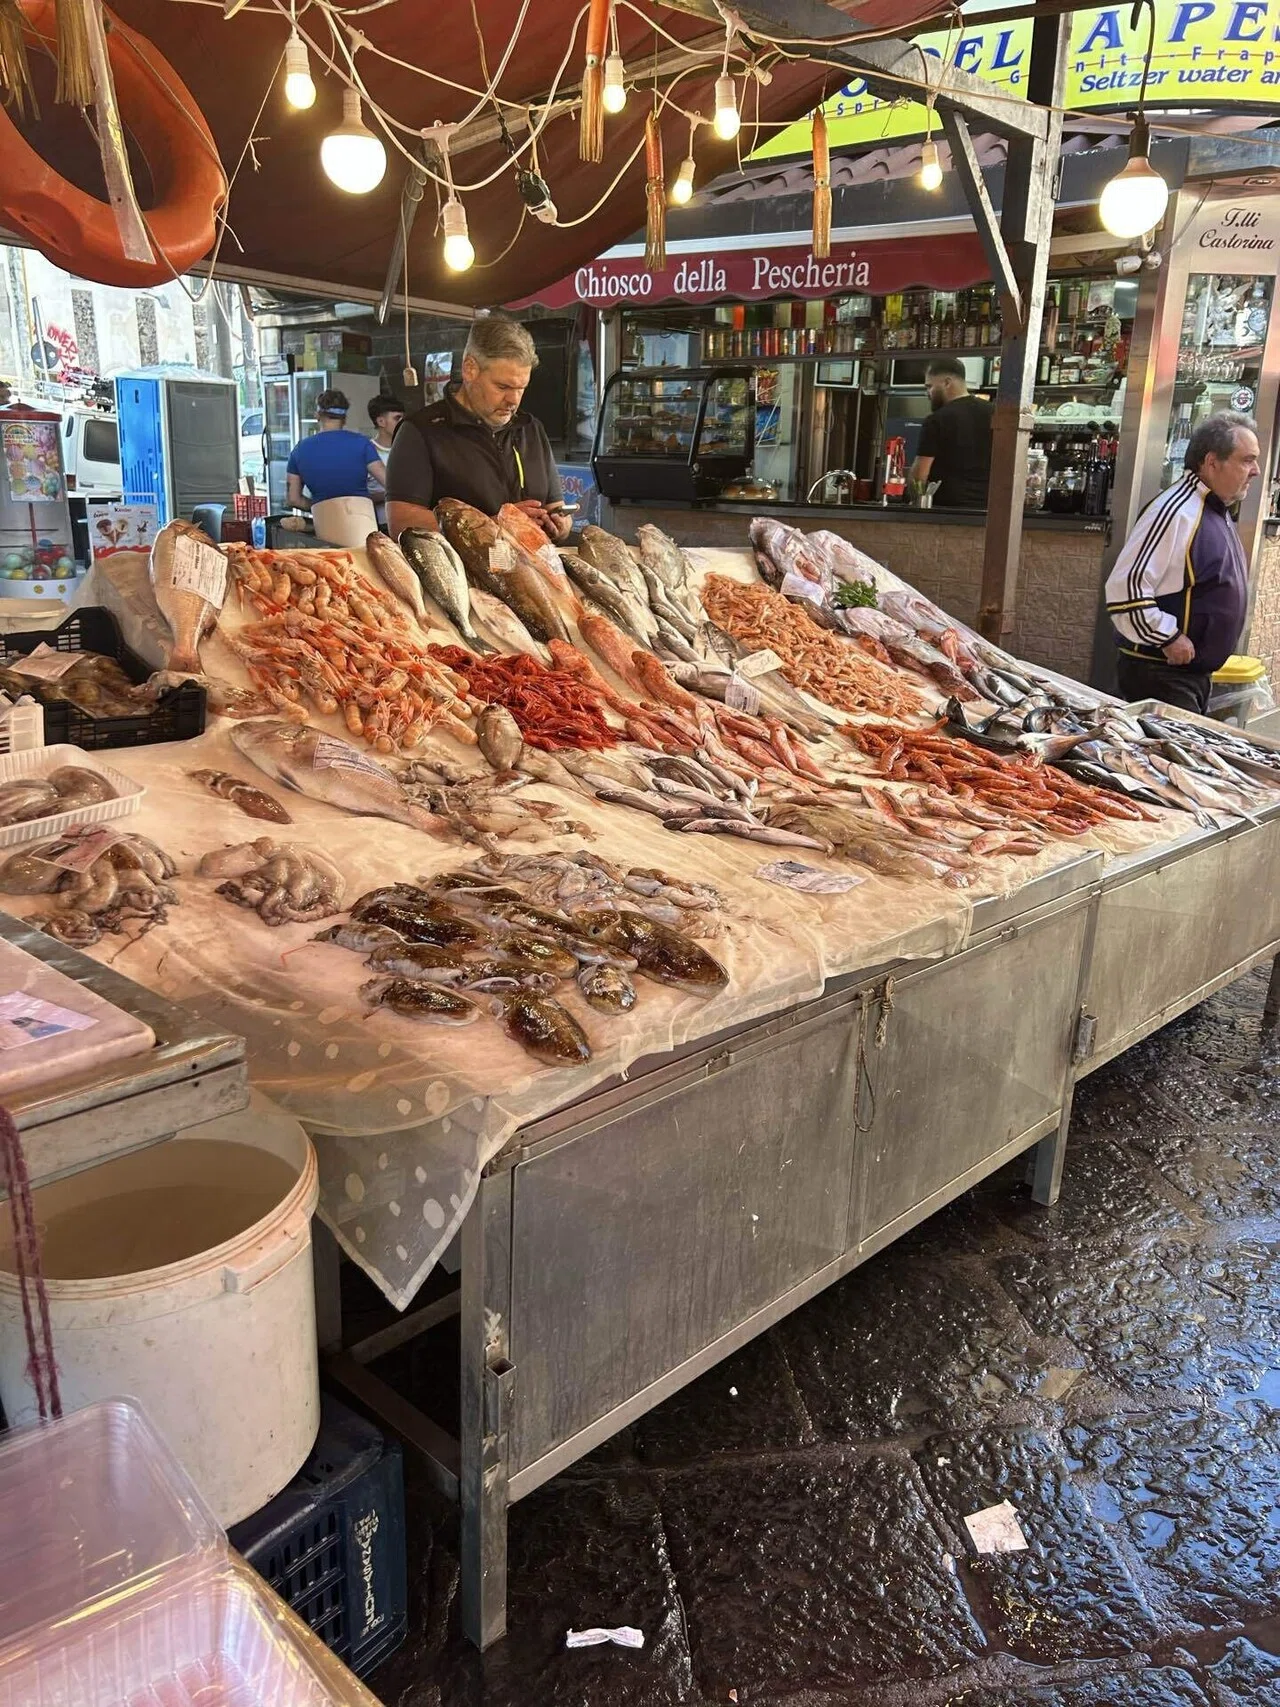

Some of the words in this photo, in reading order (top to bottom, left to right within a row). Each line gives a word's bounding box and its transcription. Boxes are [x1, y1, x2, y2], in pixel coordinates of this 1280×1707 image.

[1167, 1, 1280, 42] PE
[1080, 70, 1170, 93] Seltzer
[1178, 66, 1253, 84] water
[1199, 229, 1276, 250] Castorina
[574, 266, 653, 299] Chiosco
[674, 260, 727, 295] della
[752, 251, 871, 291] Pescheria
